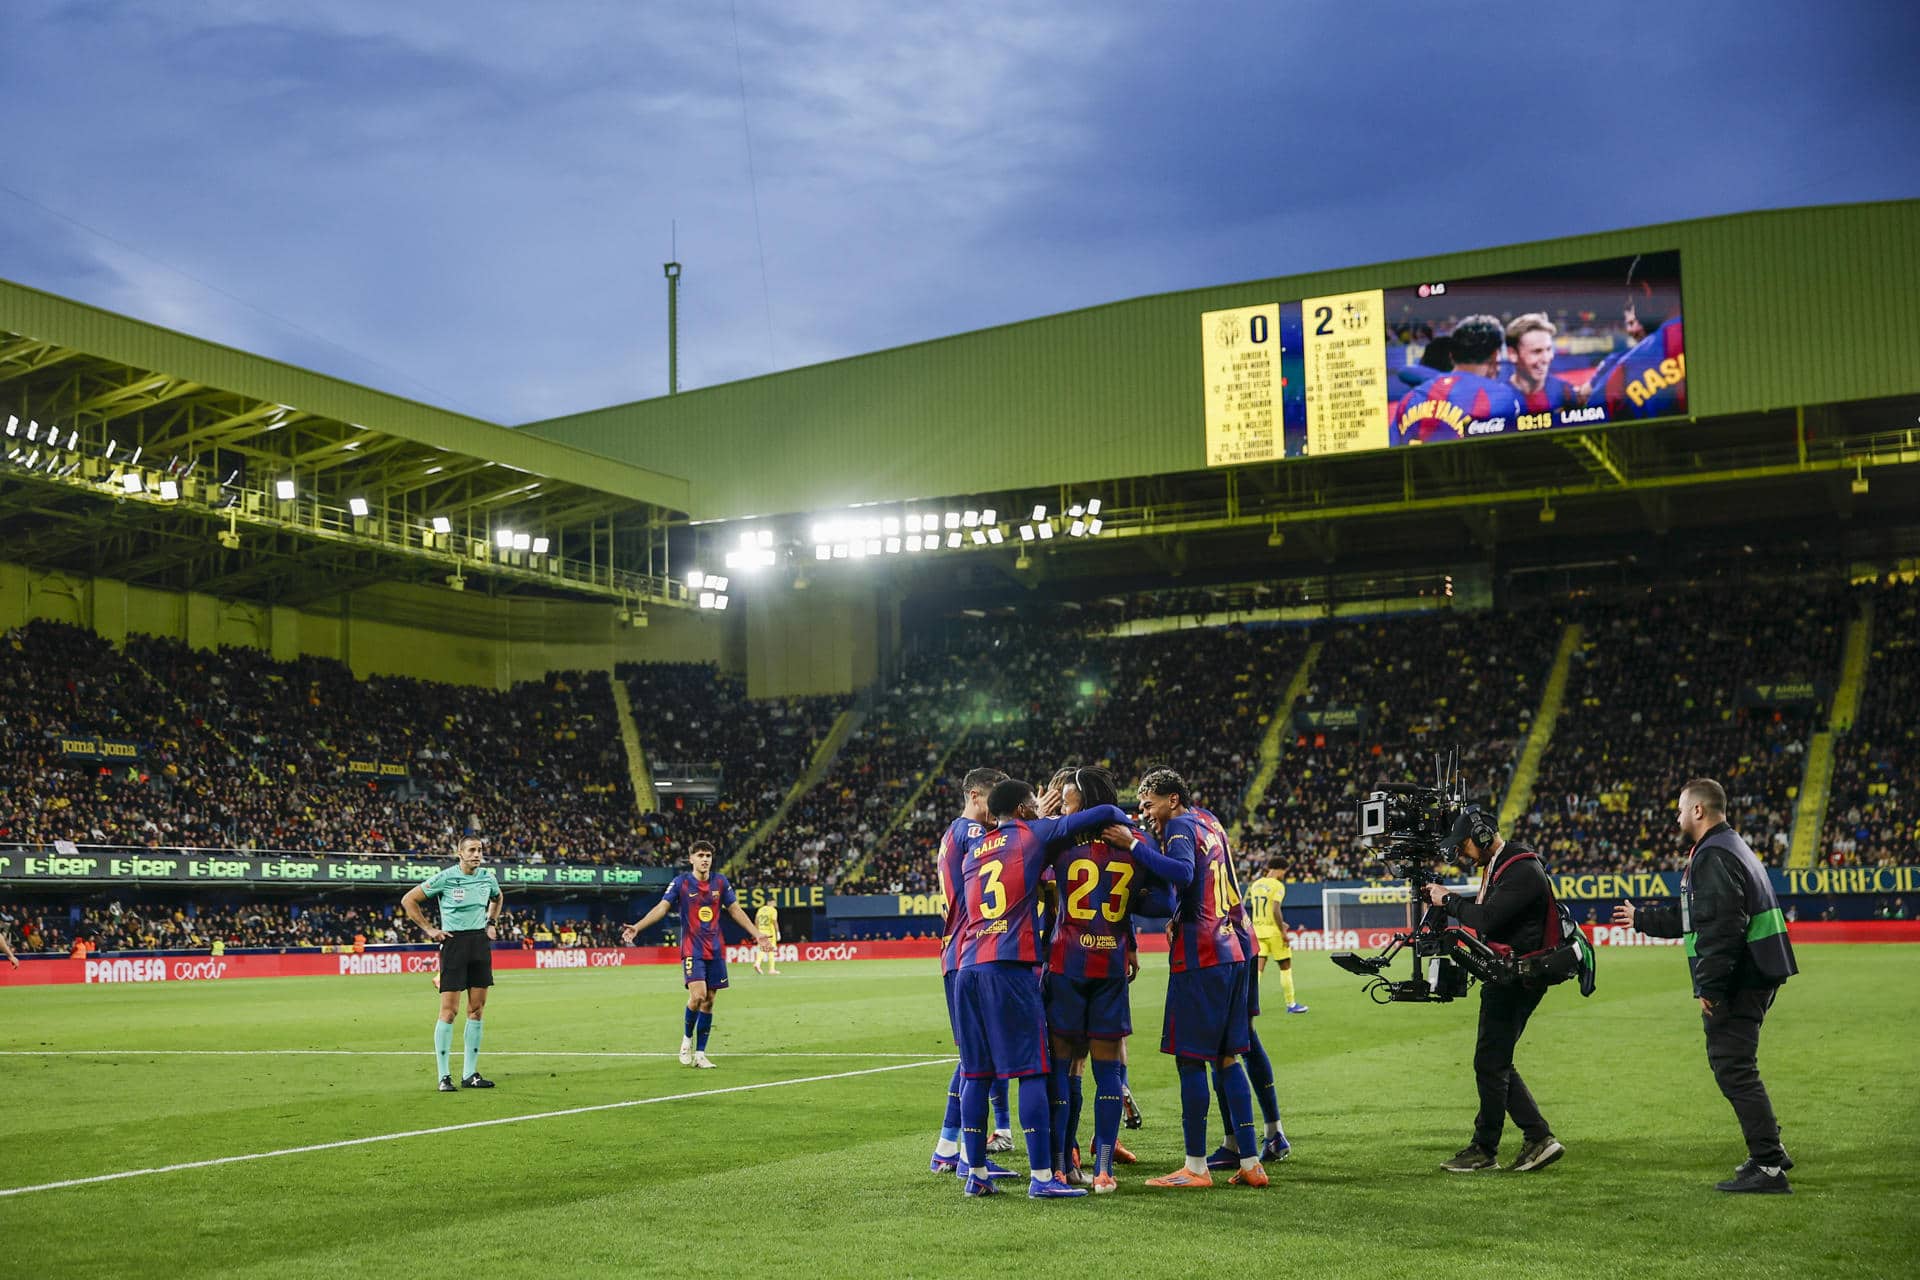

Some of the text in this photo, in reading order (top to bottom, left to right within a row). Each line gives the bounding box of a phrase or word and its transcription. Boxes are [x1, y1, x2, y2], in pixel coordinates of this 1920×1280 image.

[1250, 315, 1268, 344] 0
[1315, 306, 1335, 337] 2
[1626, 353, 1685, 407] RAS
[1560, 406, 1605, 424] LALIGA
[974, 834, 1008, 859] BALDE
[723, 886, 824, 908] ESTILE
[978, 859, 1008, 920] 3
[1067, 859, 1135, 923] 23
[1254, 895, 1268, 917] 17
[85, 959, 167, 983] PAMESA
[339, 953, 402, 975] PAMESA
[536, 949, 587, 969] PAMESA
[685, 956, 693, 970] 5
